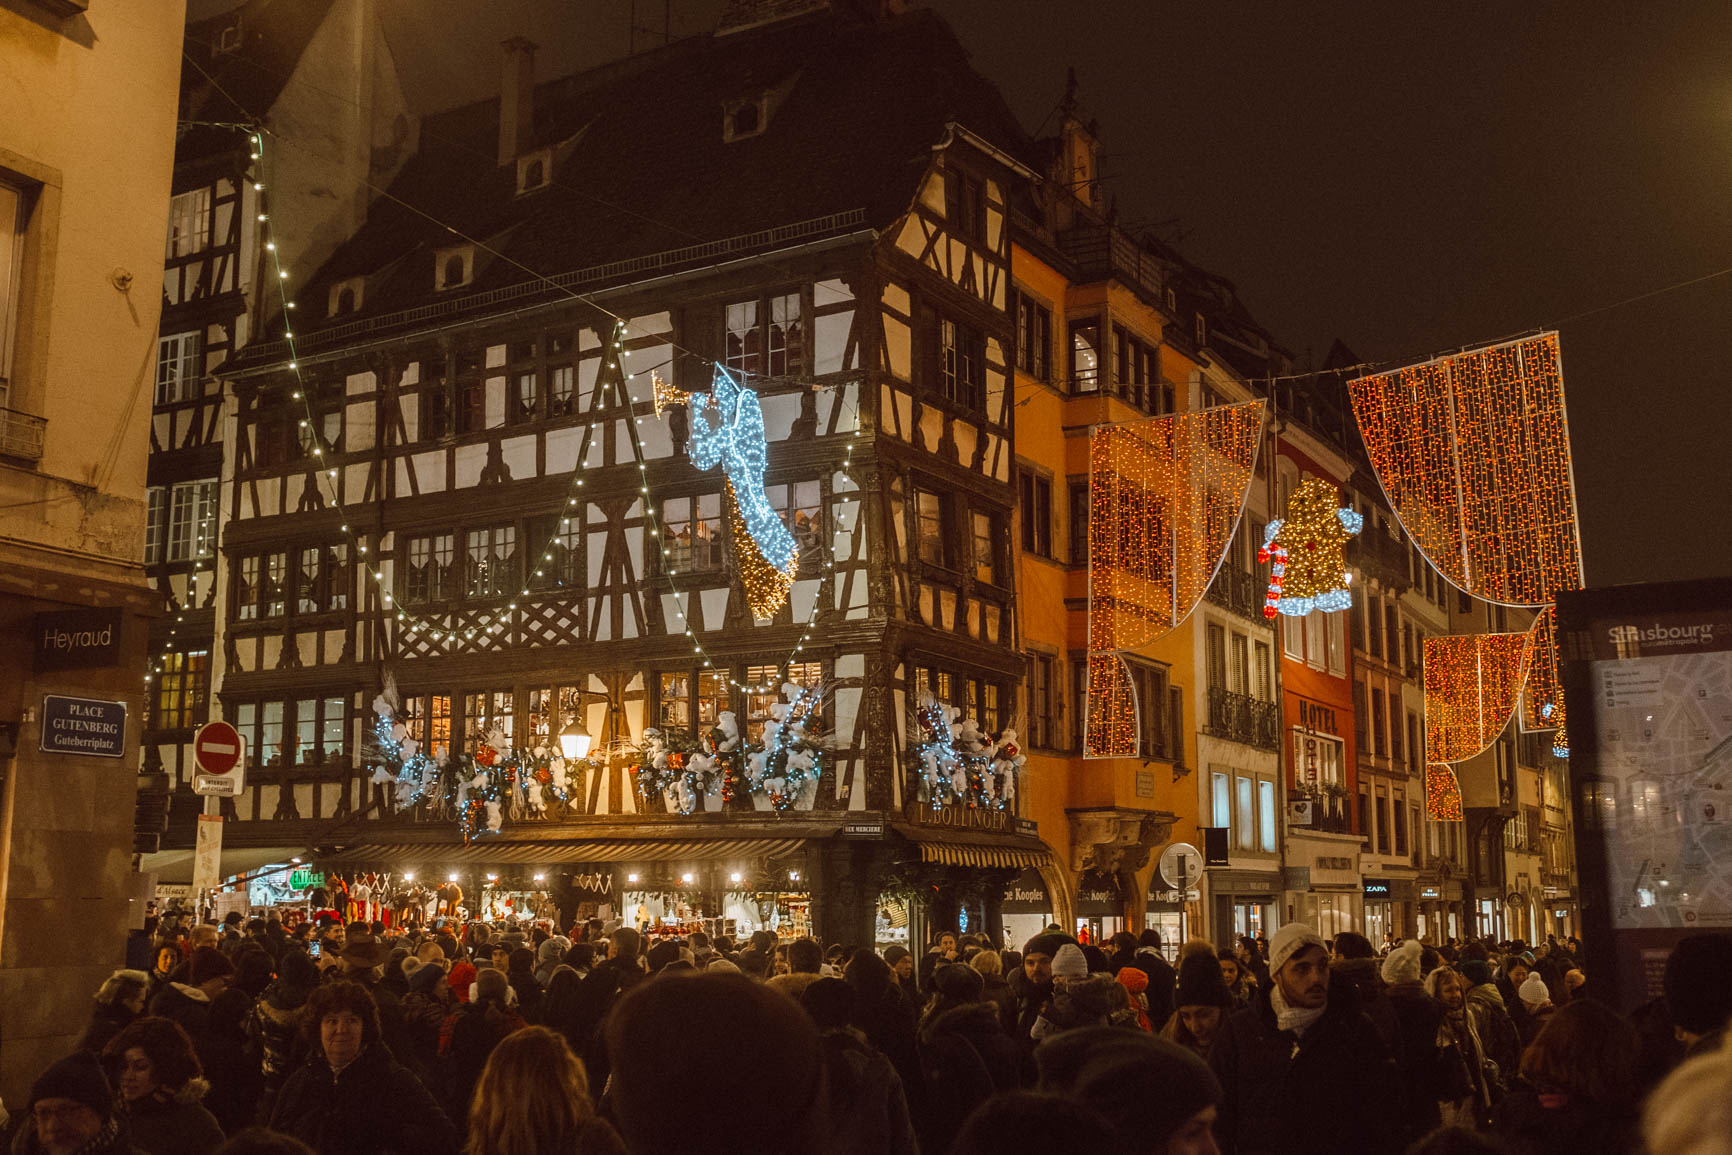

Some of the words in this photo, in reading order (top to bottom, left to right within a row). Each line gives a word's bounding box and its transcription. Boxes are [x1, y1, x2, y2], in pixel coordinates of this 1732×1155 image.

[44, 623, 112, 653] Heyraud
[69, 704, 104, 718] PLACE
[52, 717, 118, 735] GUTENBERG
[1015, 887, 1043, 903] Kooples
